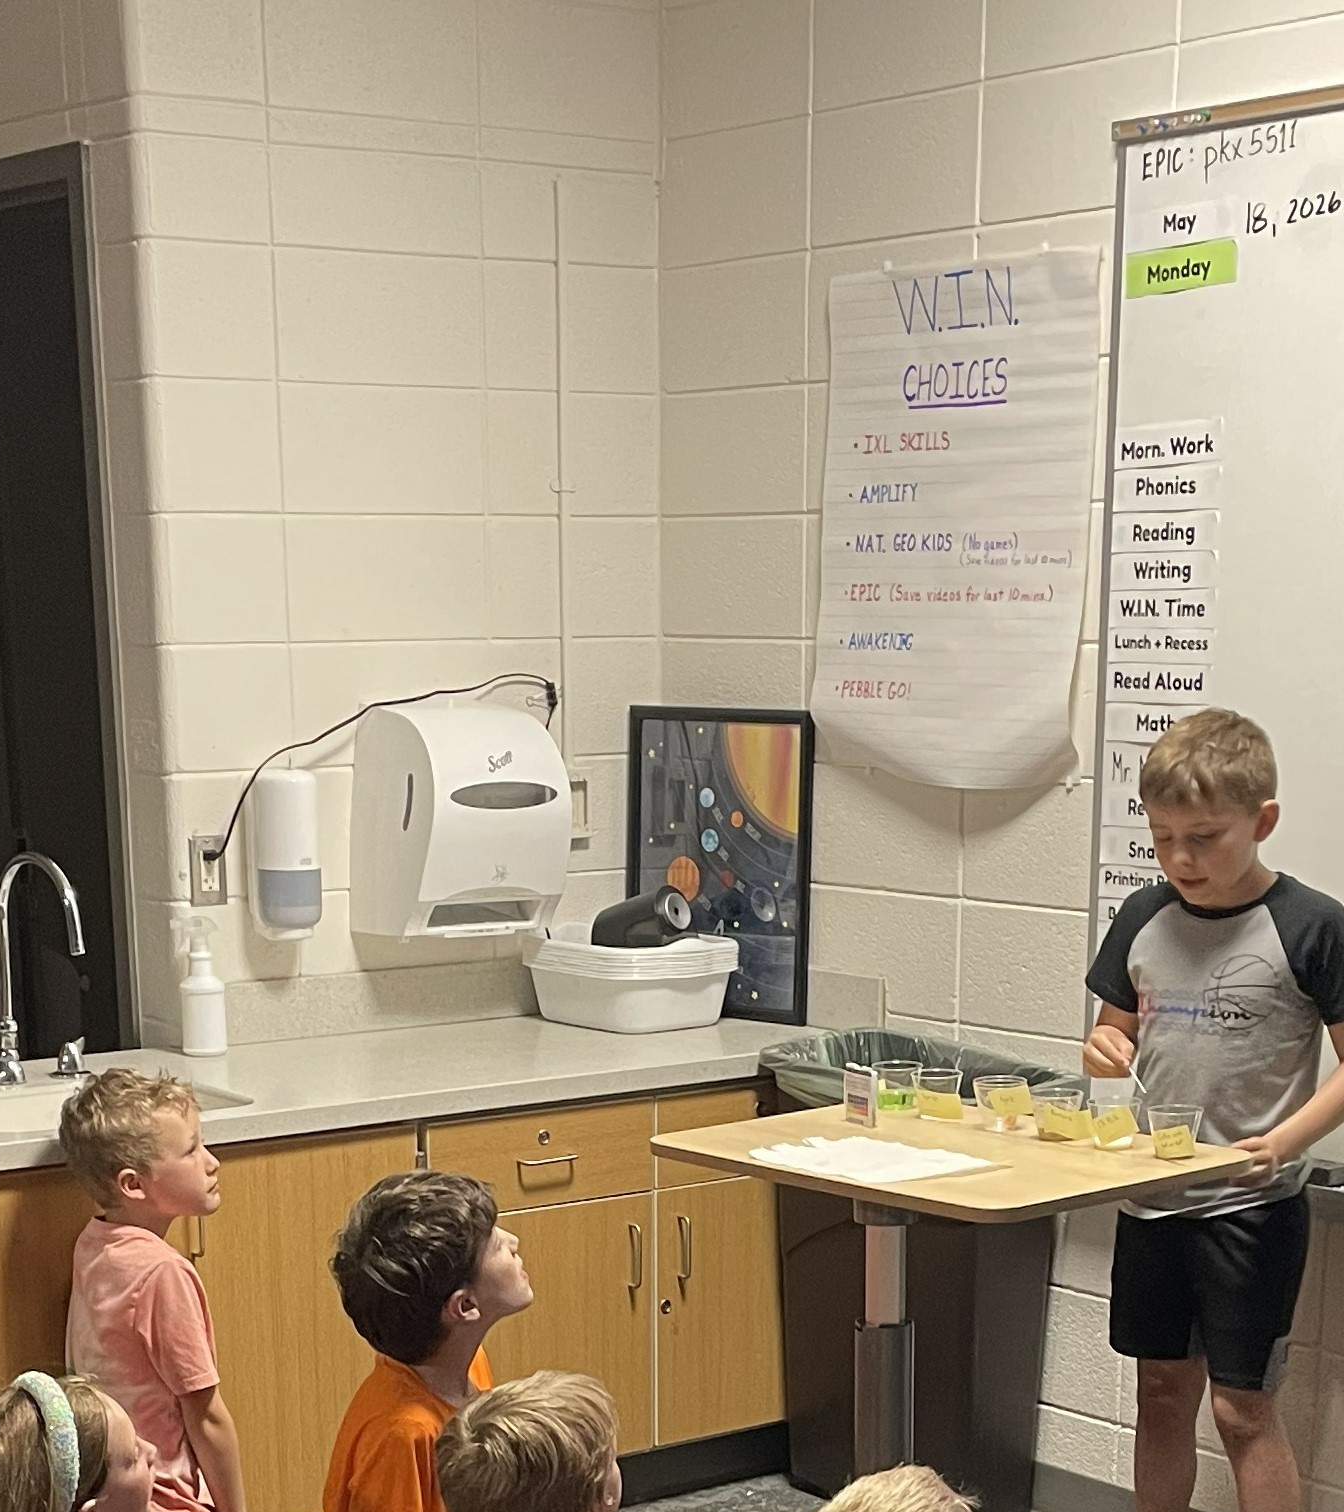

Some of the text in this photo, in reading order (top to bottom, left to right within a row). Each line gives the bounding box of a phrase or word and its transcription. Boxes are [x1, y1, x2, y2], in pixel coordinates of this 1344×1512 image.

[1163, 213, 1197, 235] May
[1286, 190, 1342, 224] 2026
[1147, 257, 1212, 285] Monday
[892, 265, 1019, 335] W.I.N.
[902, 357, 1008, 402] CHOICES
[862, 431, 951, 455] IXL SKILLS
[1120, 433, 1215, 461] Morn. Work
[859, 482, 919, 504] AMPLIFY
[1135, 475, 1197, 496] Phonics
[855, 533, 887, 554] NAT.
[893, 533, 916, 553] GEO
[921, 532, 954, 552] KIDS
[1132, 521, 1196, 546] Reading
[1133, 559, 1192, 584] Writing
[850, 584, 881, 602] EPIC
[926, 587, 961, 602] videos
[966, 585, 981, 603] for
[983, 587, 1004, 602] last
[1120, 597, 1206, 618] W.I.N. Time
[1114, 633, 1152, 650] Lunch
[1164, 635, 1209, 651] Recess
[840, 680, 912, 701] PEBBLE GO!
[1113, 671, 1204, 692] Read Aloud
[1127, 798, 1145, 816] Re
[1128, 841, 1155, 860] Sna
